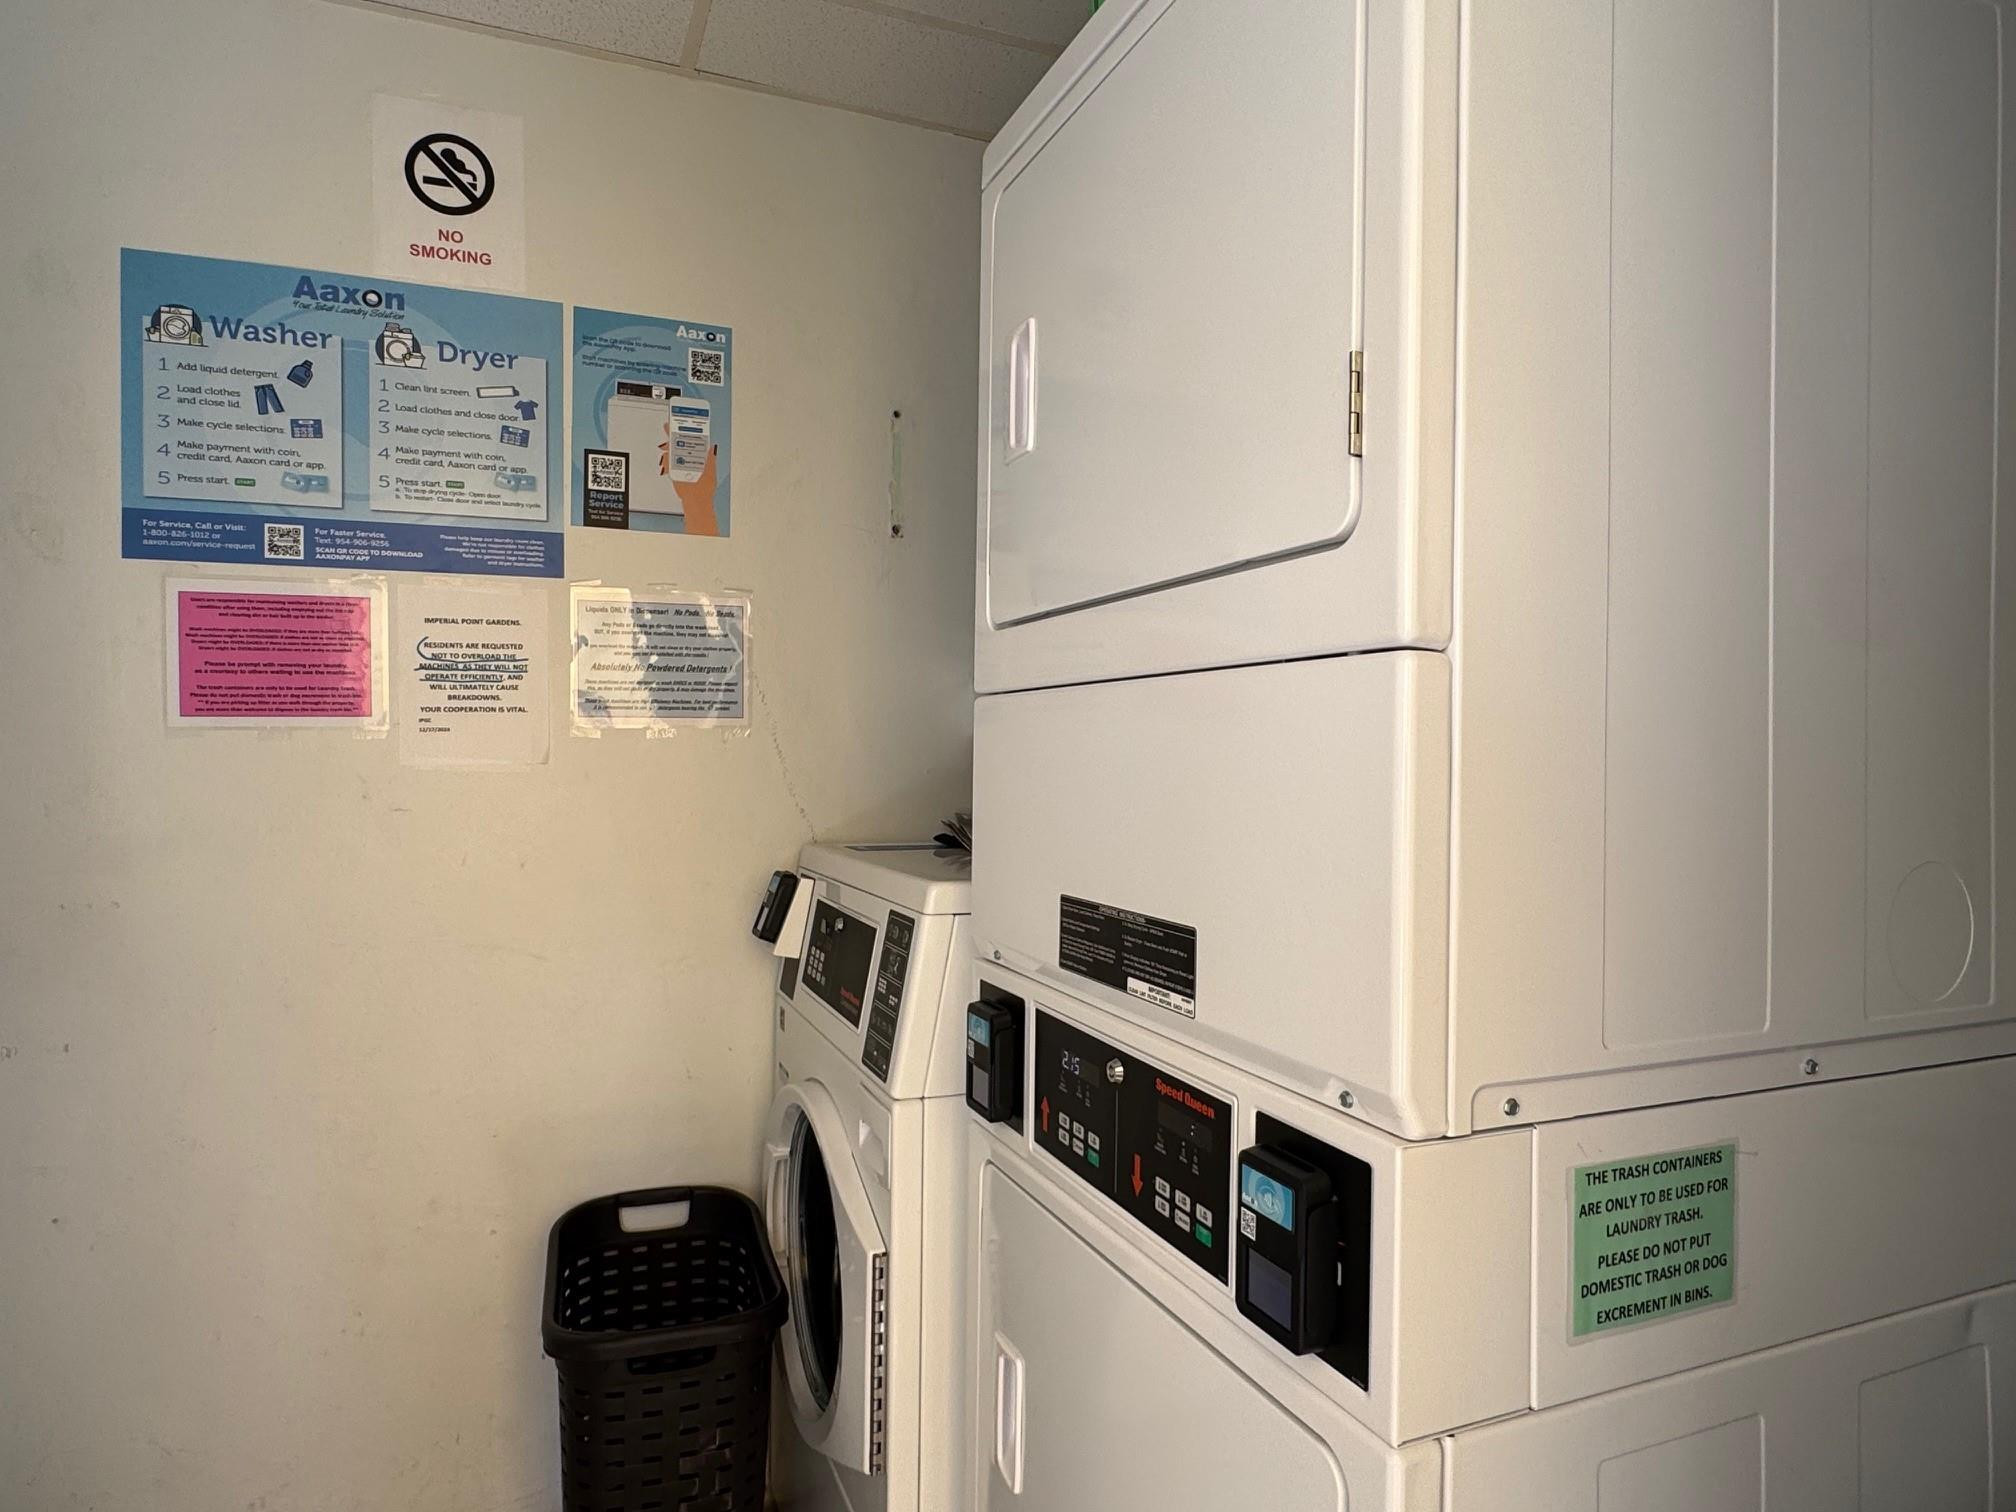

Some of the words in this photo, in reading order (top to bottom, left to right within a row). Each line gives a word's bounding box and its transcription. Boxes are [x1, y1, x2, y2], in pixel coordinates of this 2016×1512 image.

[438, 229, 463, 243] NO
[410, 244, 492, 266] SMOKING
[292, 275, 405, 311] Aaxon
[314, 302, 334, 312] Total
[336, 305, 368, 319] Laundry
[370, 308, 405, 320] Solution
[209, 315, 332, 349] Washer
[676, 325, 726, 344] Aaxon
[437, 341, 518, 372] Dryer
[159, 358, 169, 371] 1
[176, 362, 197, 371] Add
[200, 364, 228, 375] liquid
[157, 386, 171, 400] 2
[177, 384, 202, 395] Load
[205, 386, 241, 397] clothes
[380, 379, 389, 392] 1
[394, 382, 421, 392] Clean
[423, 384, 438, 394] lint
[440, 388, 471, 397] screen.
[177, 396, 196, 405] and
[198, 397, 225, 407] close
[228, 398, 241, 409] lid.
[378, 400, 390, 413] 2
[395, 404, 418, 413] Load
[420, 406, 452, 416] clothes
[454, 410, 472, 418] and
[474, 412, 496, 421] close
[158, 414, 170, 428] 3
[177, 418, 204, 427] Make
[206, 420, 233, 431] cycle
[378, 421, 390, 434] 3
[395, 425, 420, 434] Make
[422, 427, 445, 437] cycle
[447, 430, 492, 441] selections.
[156, 443, 171, 456] 4
[177, 440, 204, 450] Make
[206, 444, 250, 454] payment
[254, 446, 275, 455] with
[278, 448, 301, 458] coin,
[378, 448, 390, 460] 4
[396, 446, 420, 455] Make
[422, 449, 462, 459] payment
[464, 452, 483, 460] with
[486, 454, 506, 463] coin,
[177, 452, 205, 461] credit
[235, 455, 267, 465] Aaxon
[269, 458, 291, 468] card
[306, 462, 326, 471] app.
[396, 458, 421, 466] credit
[424, 459, 445, 468] card,
[448, 461, 476, 470] Aaxon
[478, 463, 497, 472] card
[158, 471, 171, 484] 5
[178, 474, 204, 484] Press
[378, 475, 390, 488] 5
[396, 477, 419, 487] Press
[589, 500, 624, 509] Service
[590, 492, 623, 502] Report
[143, 520, 157, 528] For
[160, 521, 193, 530] Service,
[196, 522, 212, 530] Call
[225, 523, 247, 531] Visit:
[315, 528, 328, 536] For
[143, 530, 210, 540] 1-800-826-1012
[335, 538, 390, 547] 954-906-9256
[143, 539, 256, 550] aaxon.com/service-request
[382, 550, 424, 558] DOWNLOAD
[424, 617, 460, 625] IMPERIAL
[486, 618, 522, 626] GARDENS.
[465, 642, 479, 650] ARE
[481, 642, 523, 650] REQUESTED
[512, 664, 528, 672] NOT
[591, 663, 636, 673] Absolutely
[646, 664, 685, 673] Powdered
[686, 664, 727, 674] Detergents
[1155, 1078, 1183, 1103] Speed
[1184, 1092, 1215, 1119] Queen
[1586, 1171, 1608, 1187] THE
[1612, 1164, 1650, 1182] TRASH
[1653, 1150, 1723, 1175] CONTAINERS
[1579, 1201, 1602, 1219] ARE
[1605, 1195, 1637, 1213] ONLY
[1640, 1192, 1655, 1207] TO
[1658, 1188, 1673, 1202] BE
[1676, 1182, 1704, 1200] USED
[1708, 1178, 1728, 1193] FOR
[1606, 1215, 1661, 1238] LAUNDRY
[1664, 1207, 1704, 1226] TRASH.
[1598, 1248, 1640, 1269] PLEASE
[1643, 1244, 1660, 1260] DO
[1664, 1238, 1688, 1256] NOT
[1690, 1233, 1712, 1250] PUT
[1581, 1273, 1642, 1299] DOMESTIC
[1645, 1264, 1682, 1284] TRASH
[1684, 1260, 1700, 1275] OR
[1702, 1254, 1728, 1271] DOG
[1597, 1296, 1666, 1325] EXCREMENT
[1670, 1293, 1682, 1307] IN
[1685, 1286, 1713, 1304] BINS.
